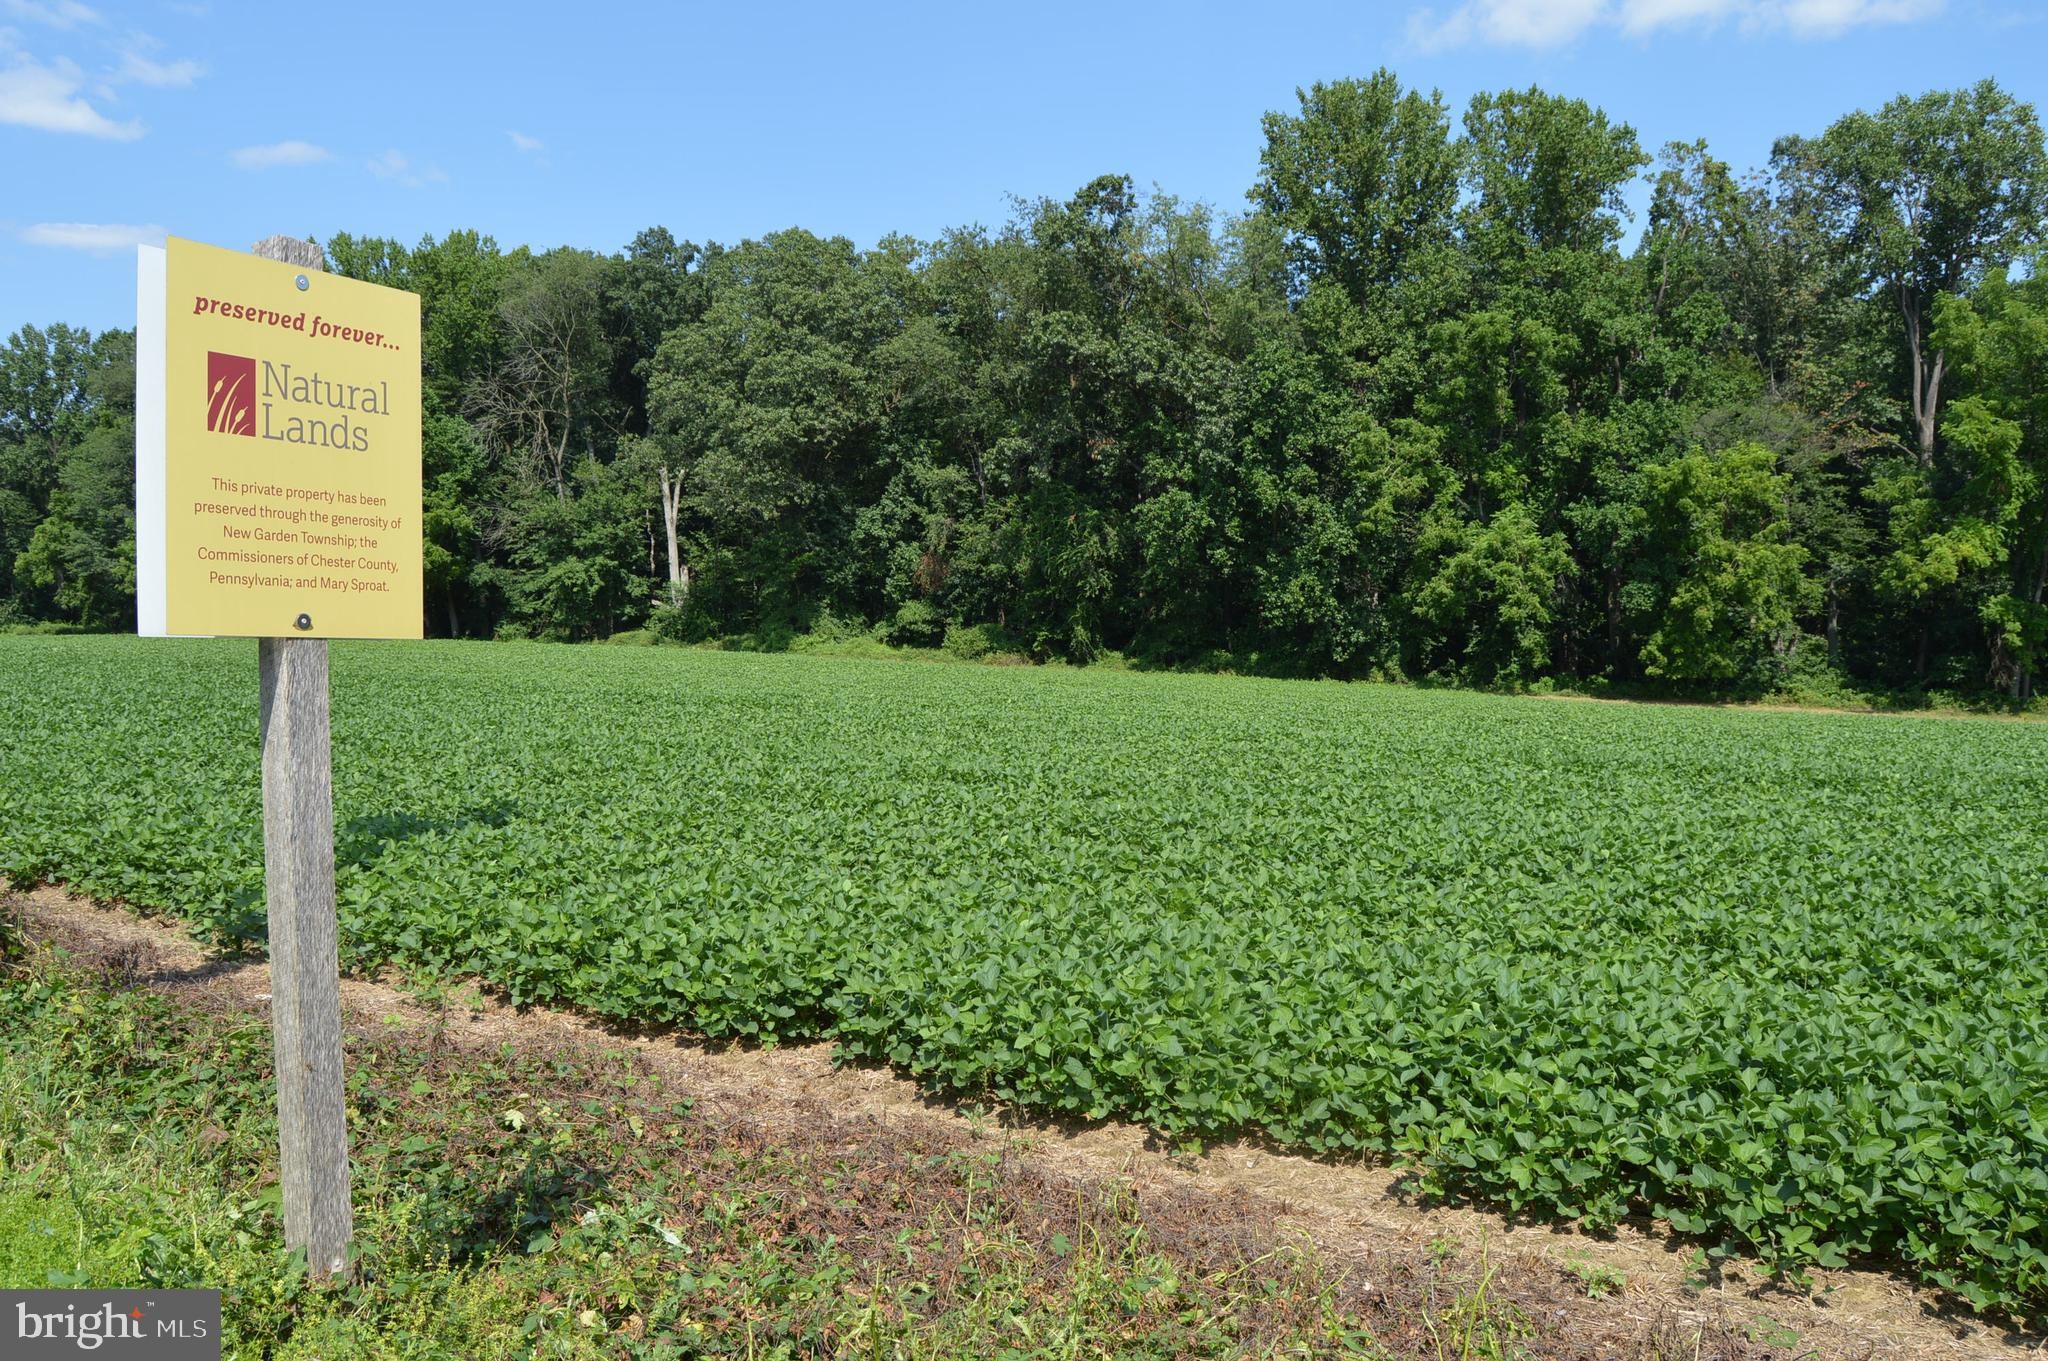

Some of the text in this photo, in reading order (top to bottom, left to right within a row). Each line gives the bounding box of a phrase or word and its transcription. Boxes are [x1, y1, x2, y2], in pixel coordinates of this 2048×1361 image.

[193, 296, 400, 350] preserved forever...
[262, 360, 390, 416] Natural
[262, 403, 368, 452] Lands
[212, 477, 386, 506] This private property has been
[194, 502, 402, 530] preserved through the generosity of
[223, 525, 378, 549] New Garden Township; the
[198, 547, 399, 574] Commissioners of Chester County,
[210, 571, 389, 593] Pennsylvania; and Mary Sproat.
